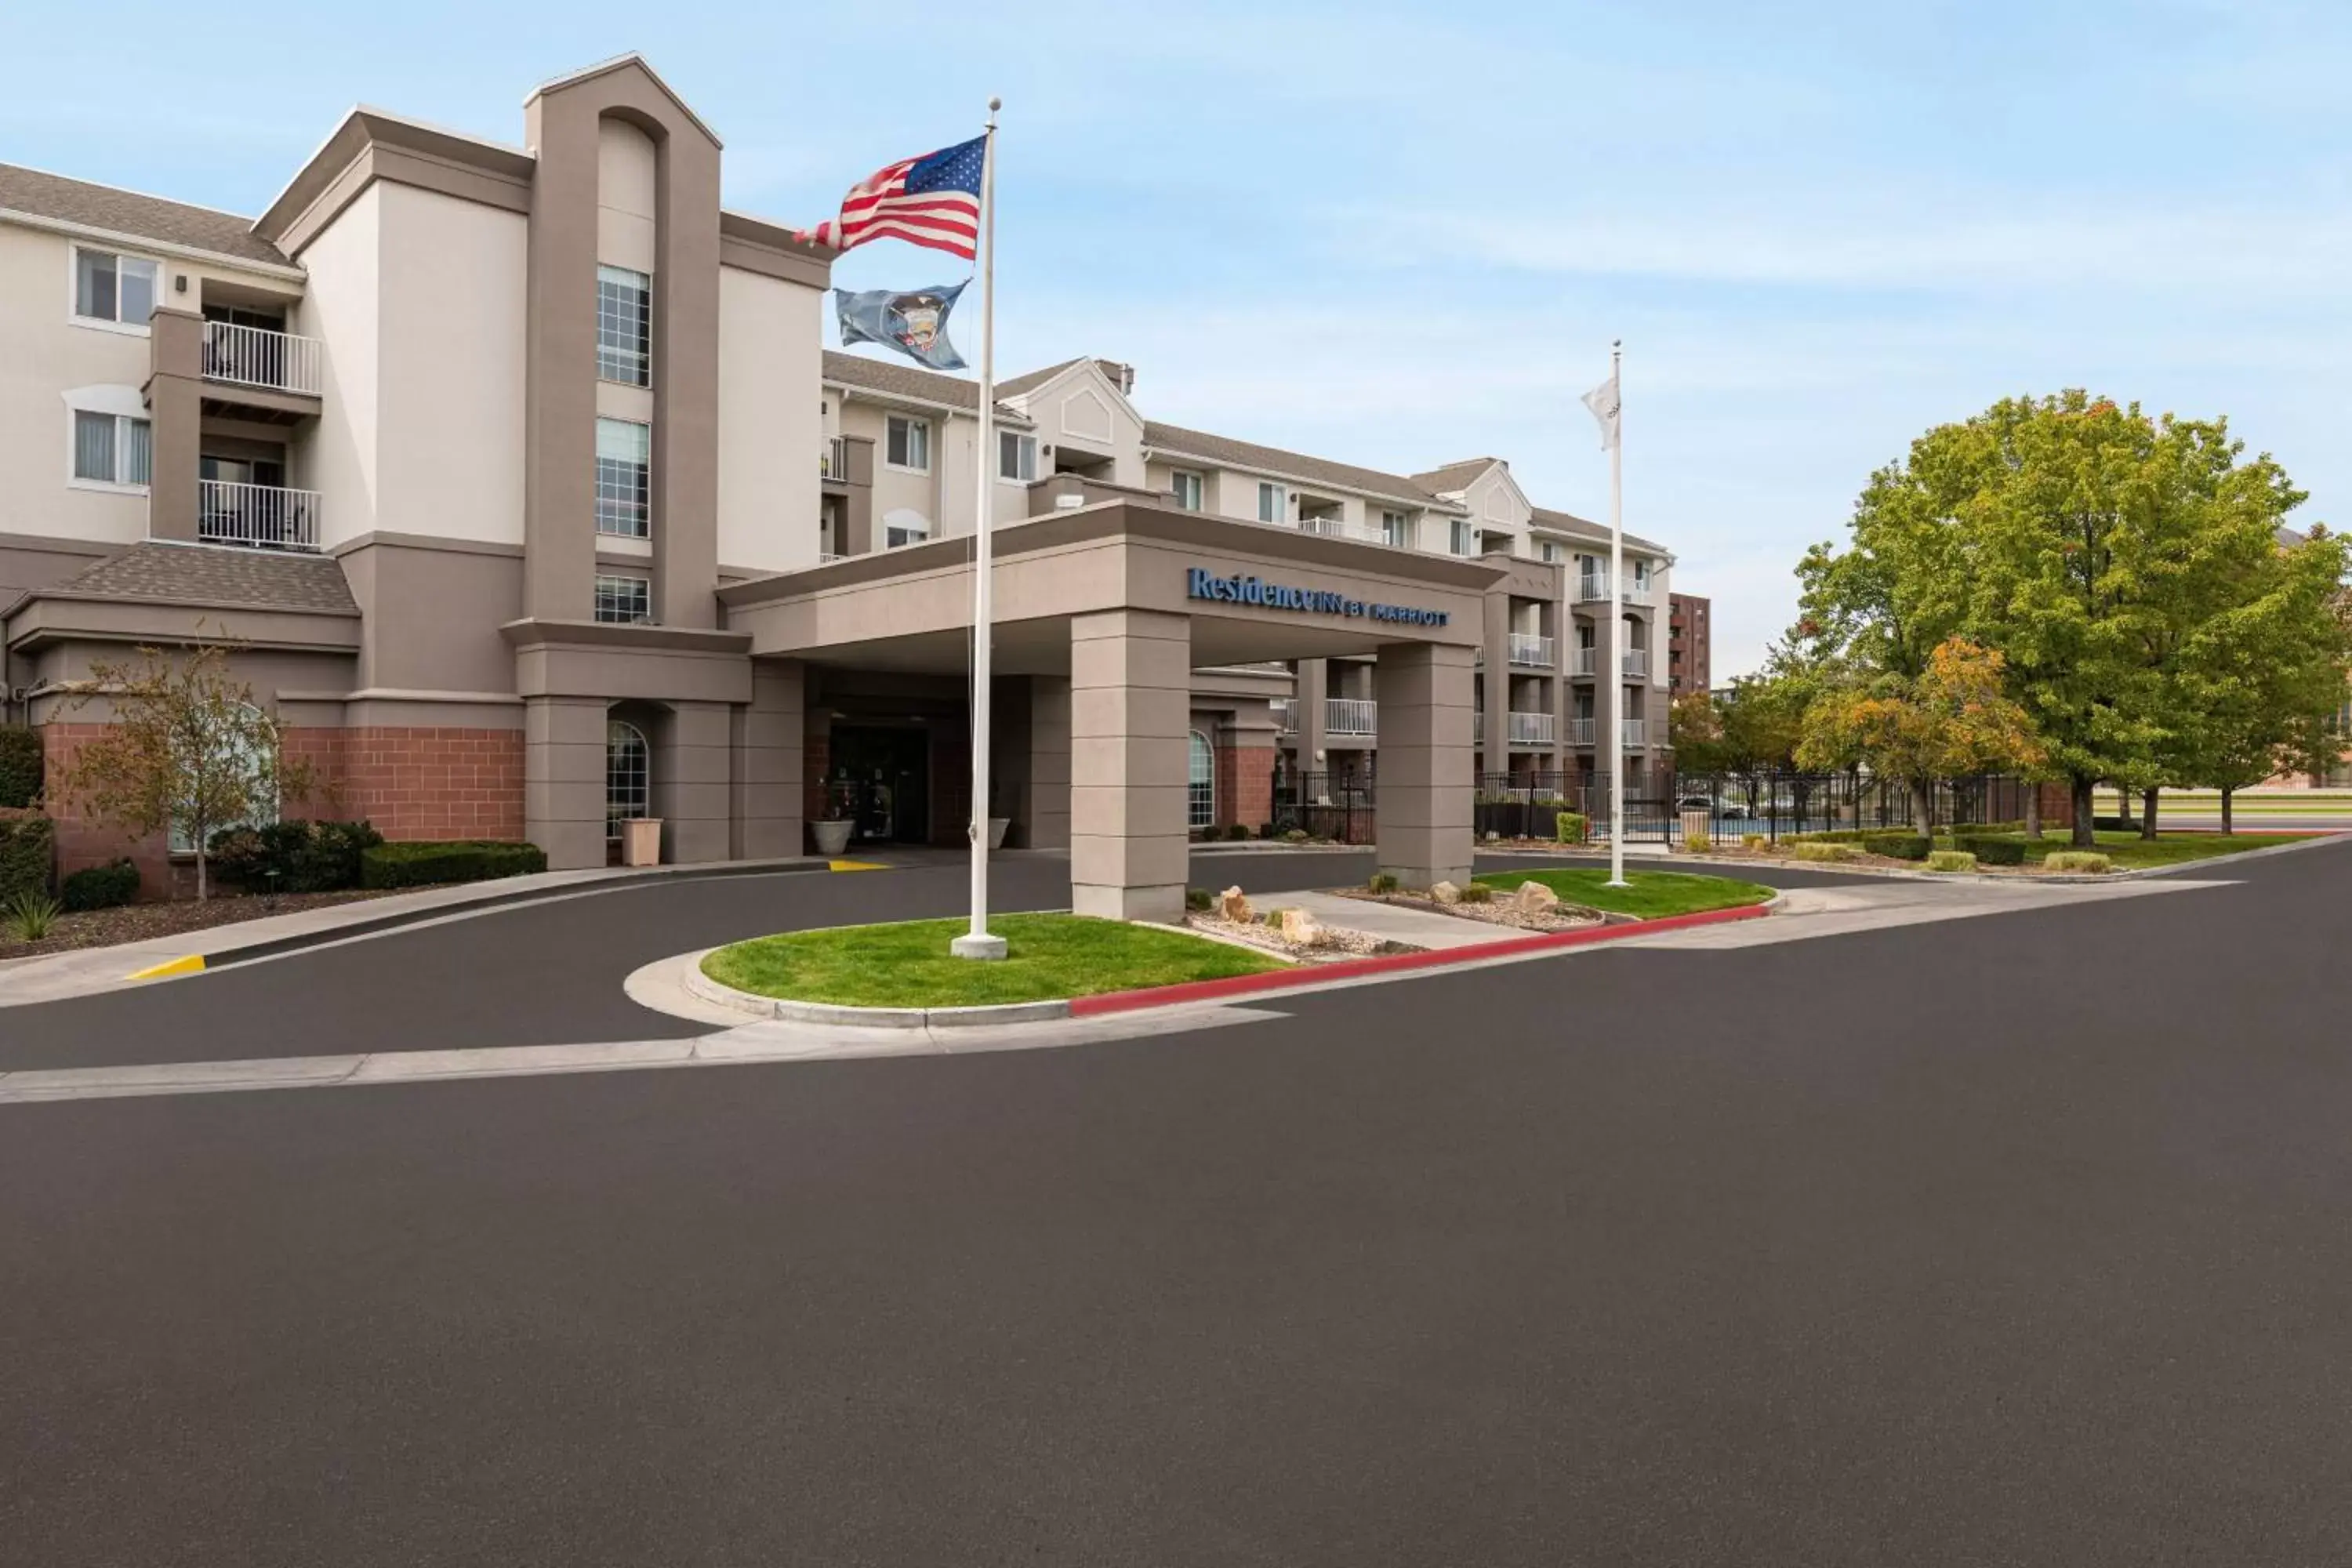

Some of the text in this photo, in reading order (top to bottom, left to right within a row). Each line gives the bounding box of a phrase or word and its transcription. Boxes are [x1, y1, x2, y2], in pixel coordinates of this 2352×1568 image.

[1188, 568, 1449, 626] Residence INN BY MARRIOTT
